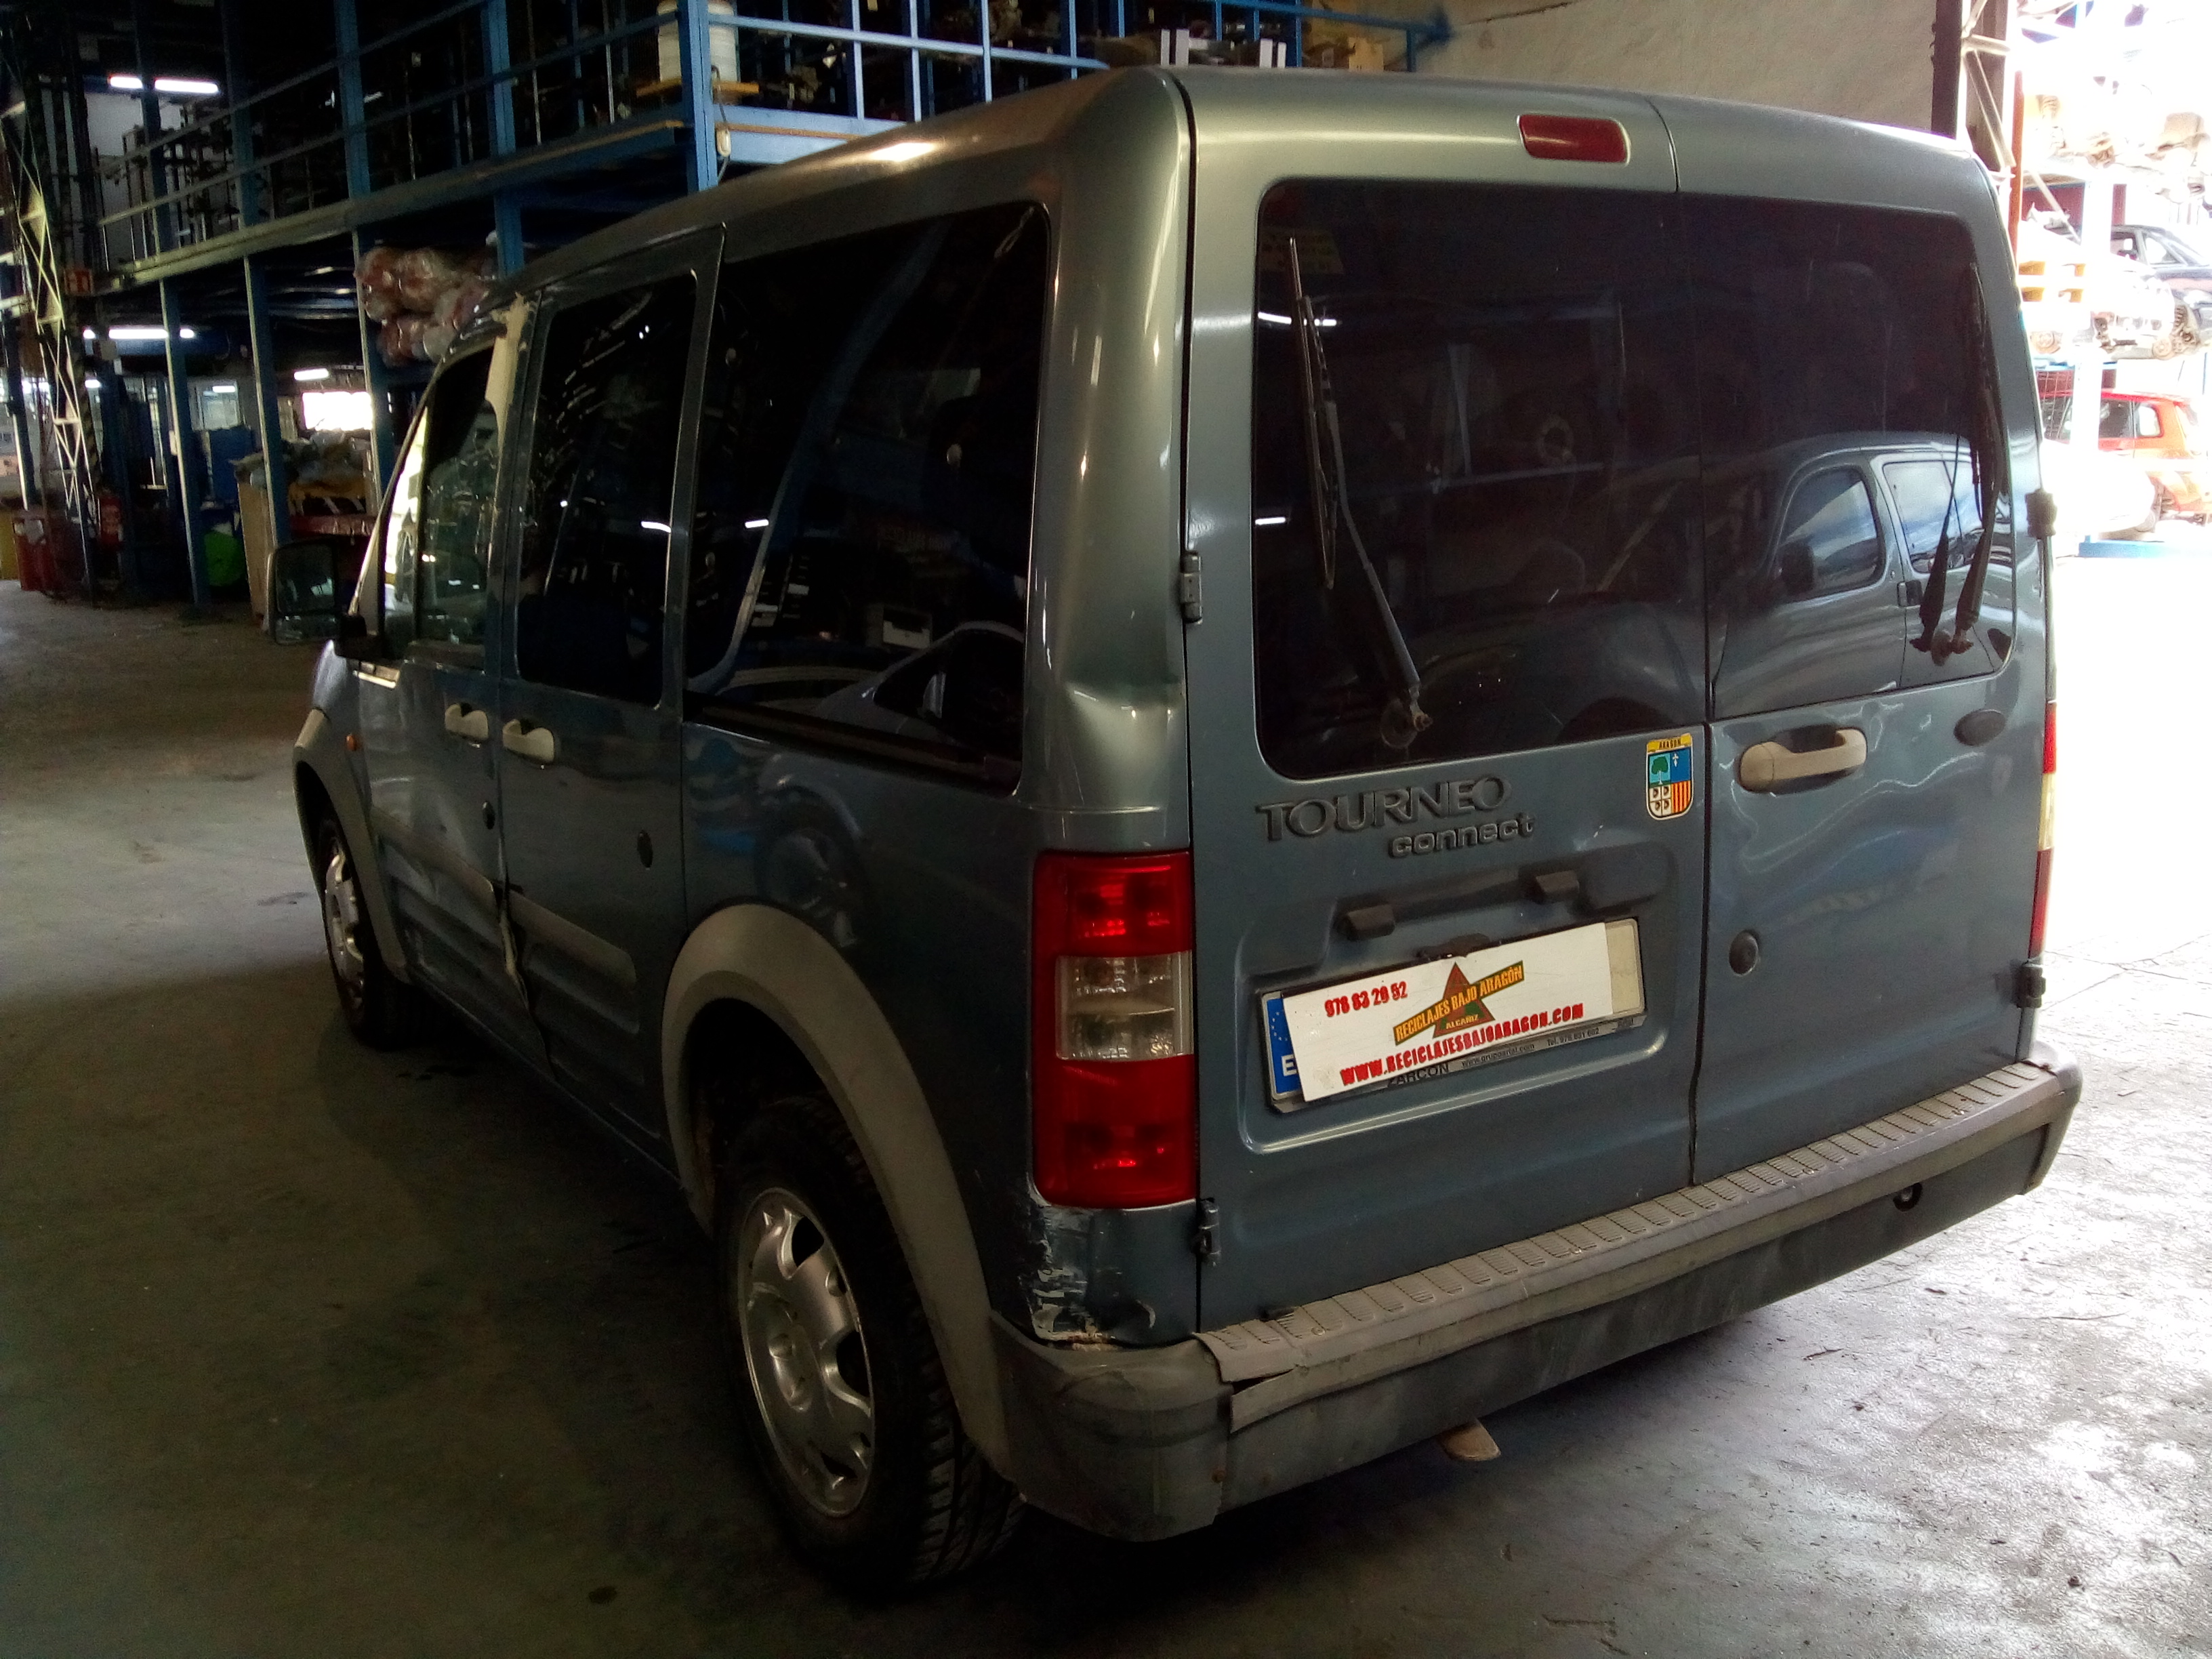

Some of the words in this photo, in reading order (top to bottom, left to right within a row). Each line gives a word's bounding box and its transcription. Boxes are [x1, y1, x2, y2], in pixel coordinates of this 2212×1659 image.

[1256, 775, 1511, 842] TOURNEO
[1390, 813, 1535, 858] connect
[1325, 996, 1350, 1017] 978
[1395, 1000, 1450, 1042] RECICLAJES
[1451, 985, 1477, 1010] BAJO
[1479, 964, 1523, 997] ARAGÓN
[1282, 1054, 1298, 1076] E
[1340, 1003, 1584, 1086] WWW.RECICLAJESBAJOARAGON.COM
